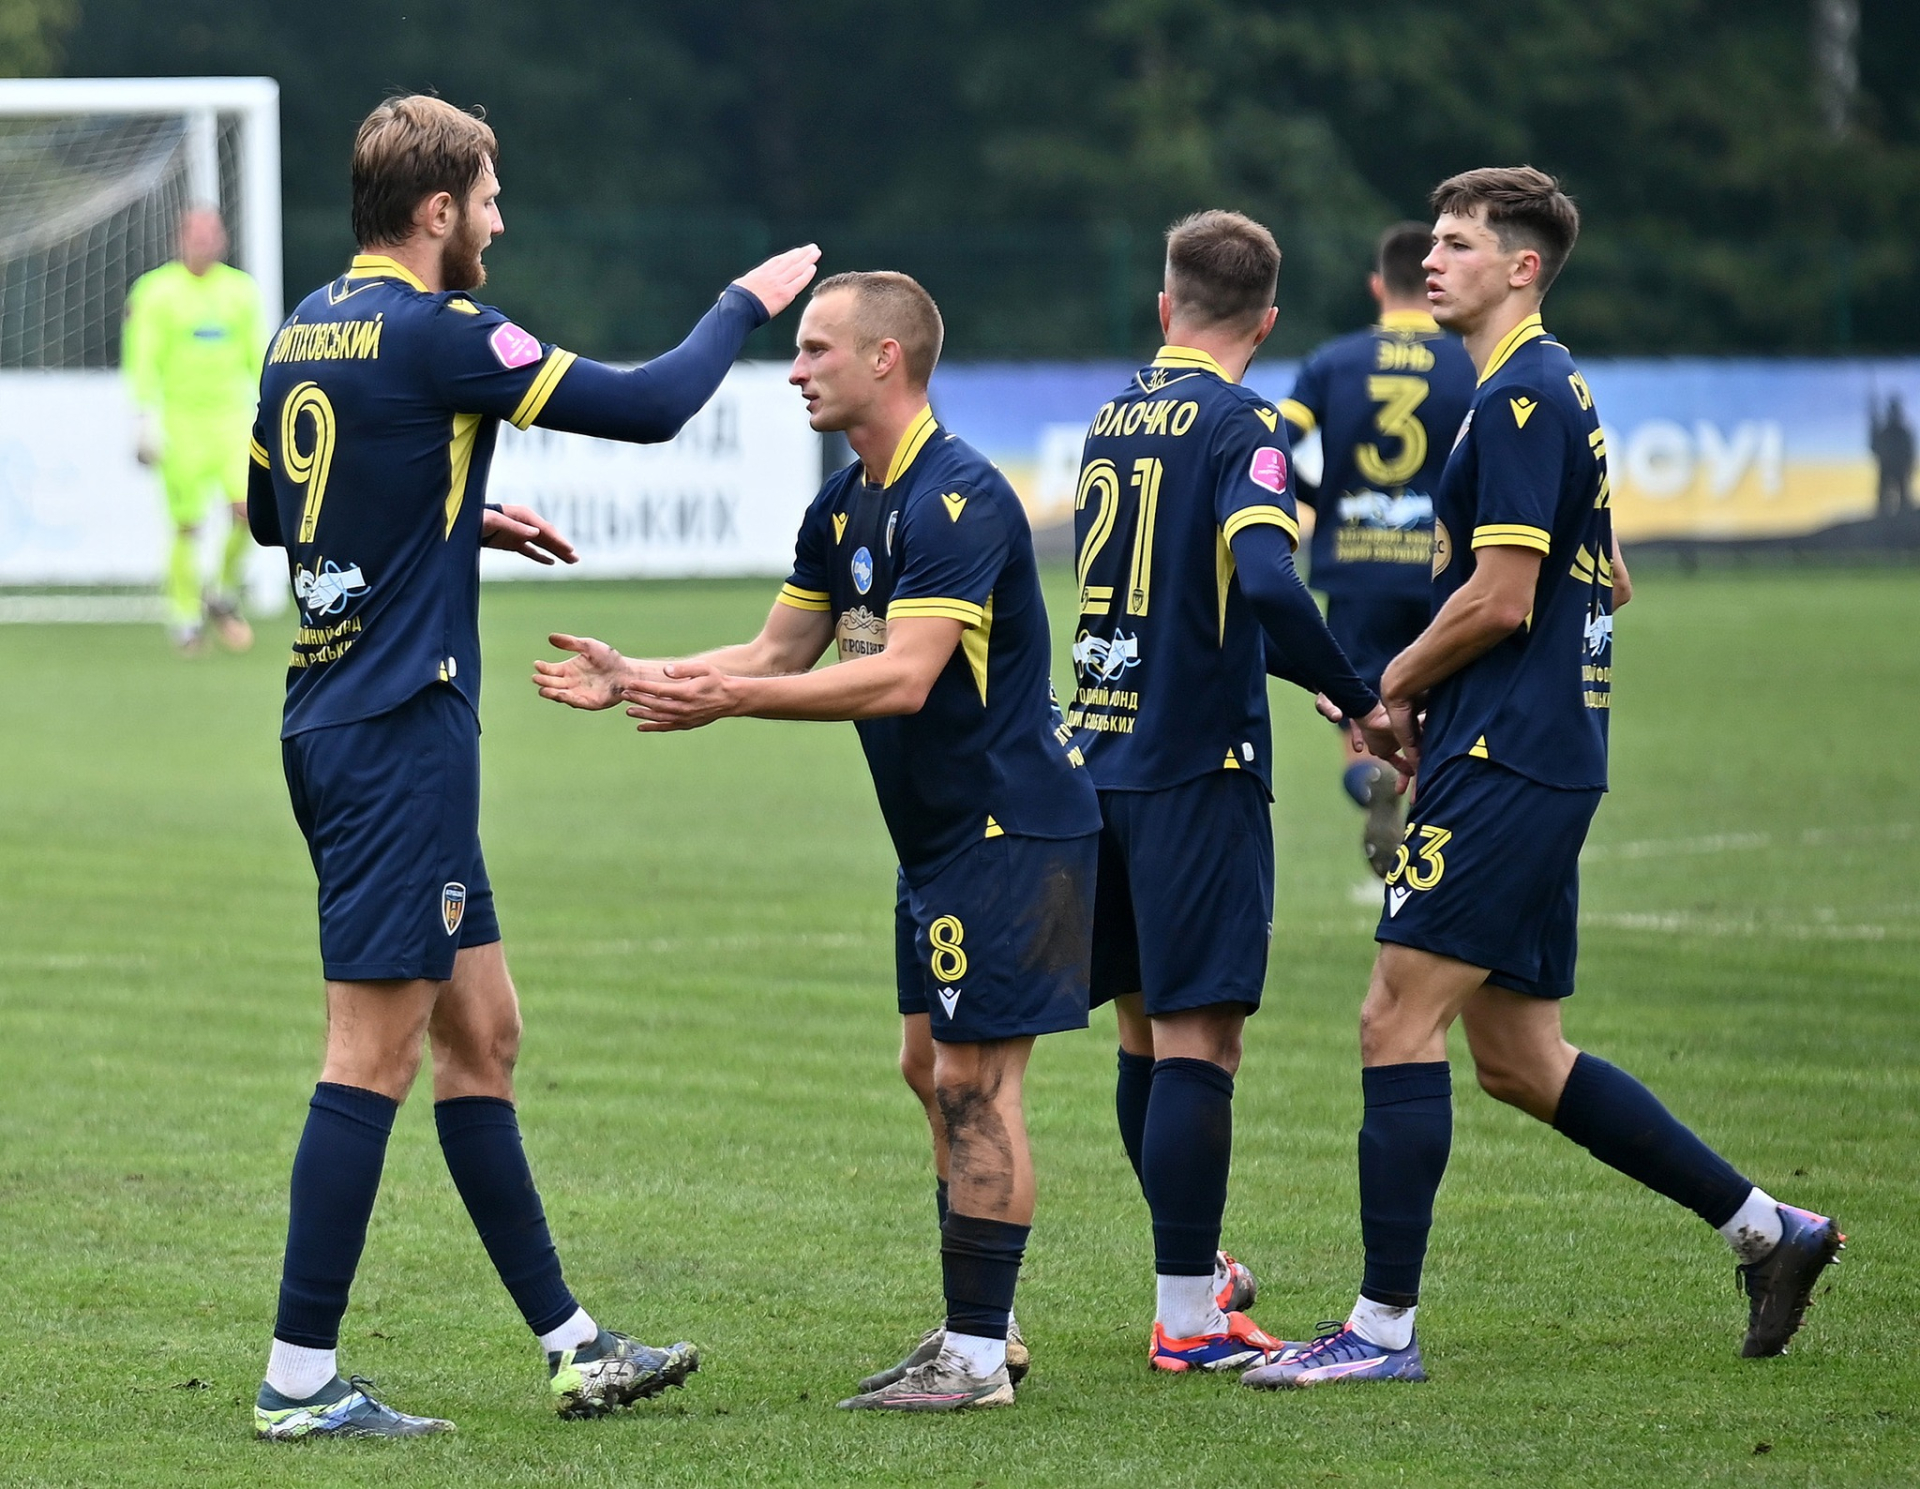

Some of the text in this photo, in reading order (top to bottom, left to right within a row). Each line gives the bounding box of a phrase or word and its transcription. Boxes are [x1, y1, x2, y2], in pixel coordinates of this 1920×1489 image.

[281, 380, 336, 544] 9
[1088, 399, 1199, 439] ОЛОЧКО
[1356, 374, 1430, 486] 3
[1075, 457, 1164, 617] 21
[929, 914, 968, 983] 8
